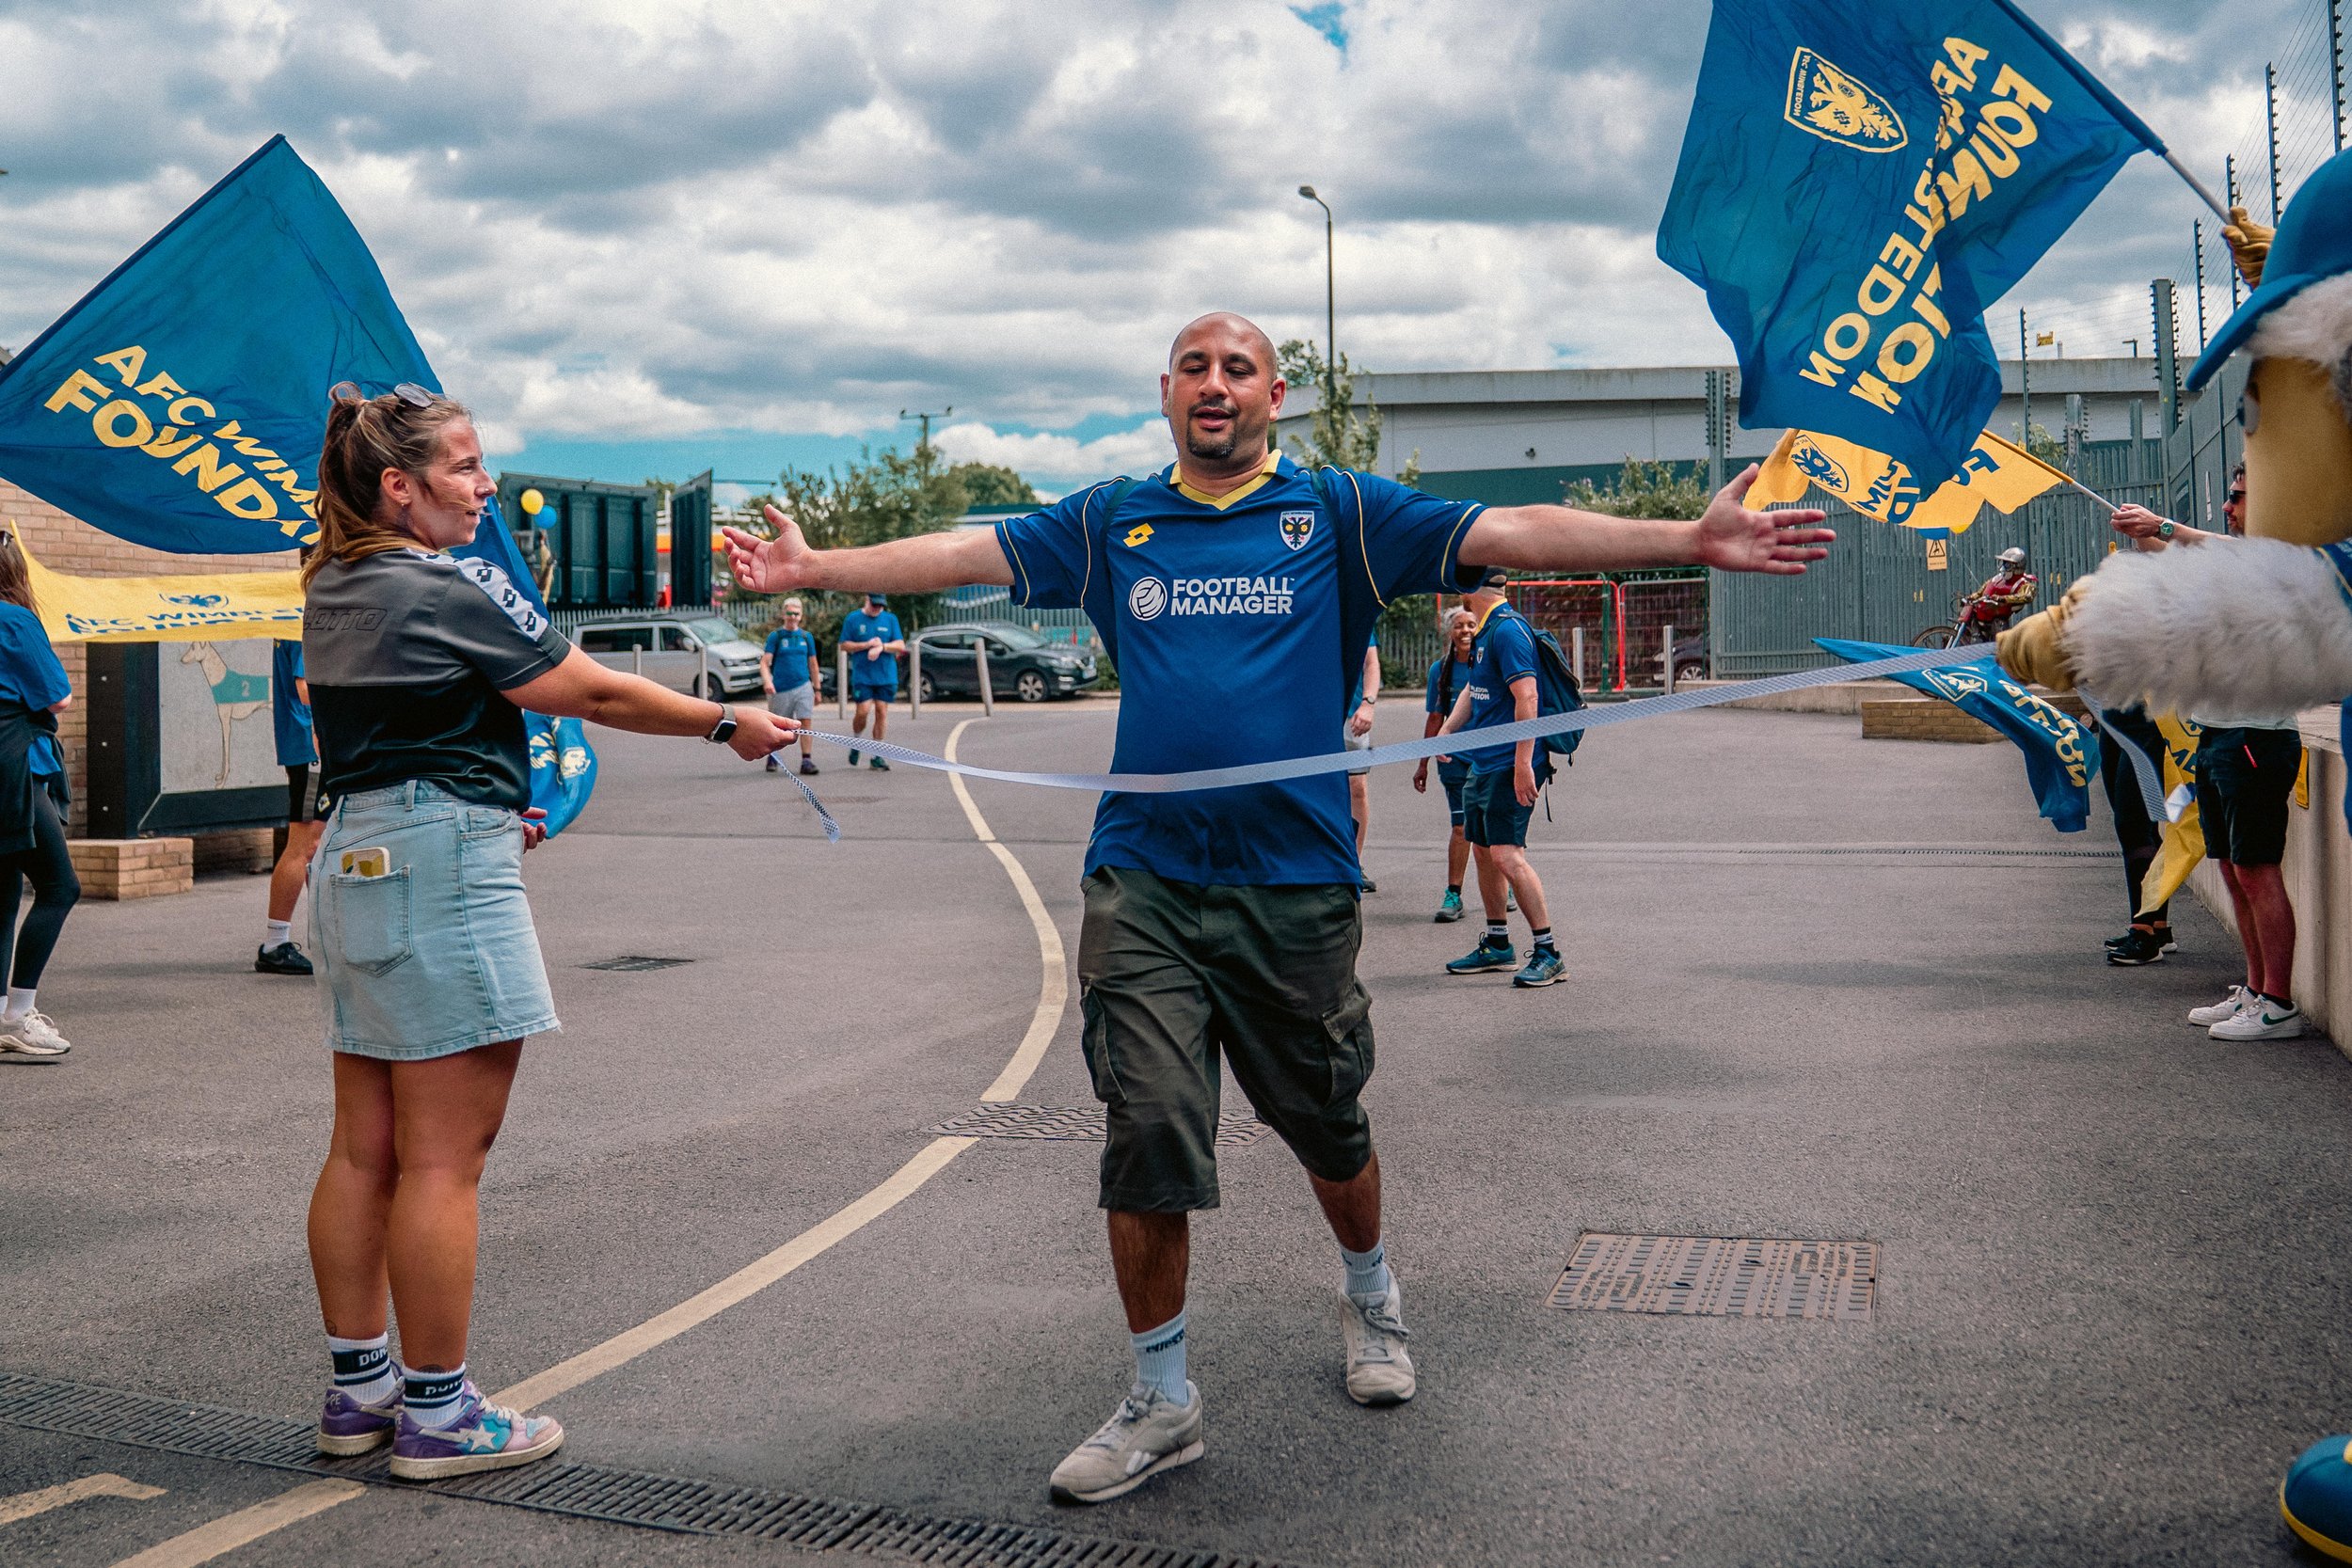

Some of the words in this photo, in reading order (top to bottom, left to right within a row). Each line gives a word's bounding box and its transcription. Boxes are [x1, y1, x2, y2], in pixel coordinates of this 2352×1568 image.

[93, 344, 216, 426] AFC
[1172, 576, 1295, 597] FOOTBALL
[1170, 595, 1293, 616] MANAGER
[241, 680, 250, 697] 2
[358, 1347, 388, 1367] DON
